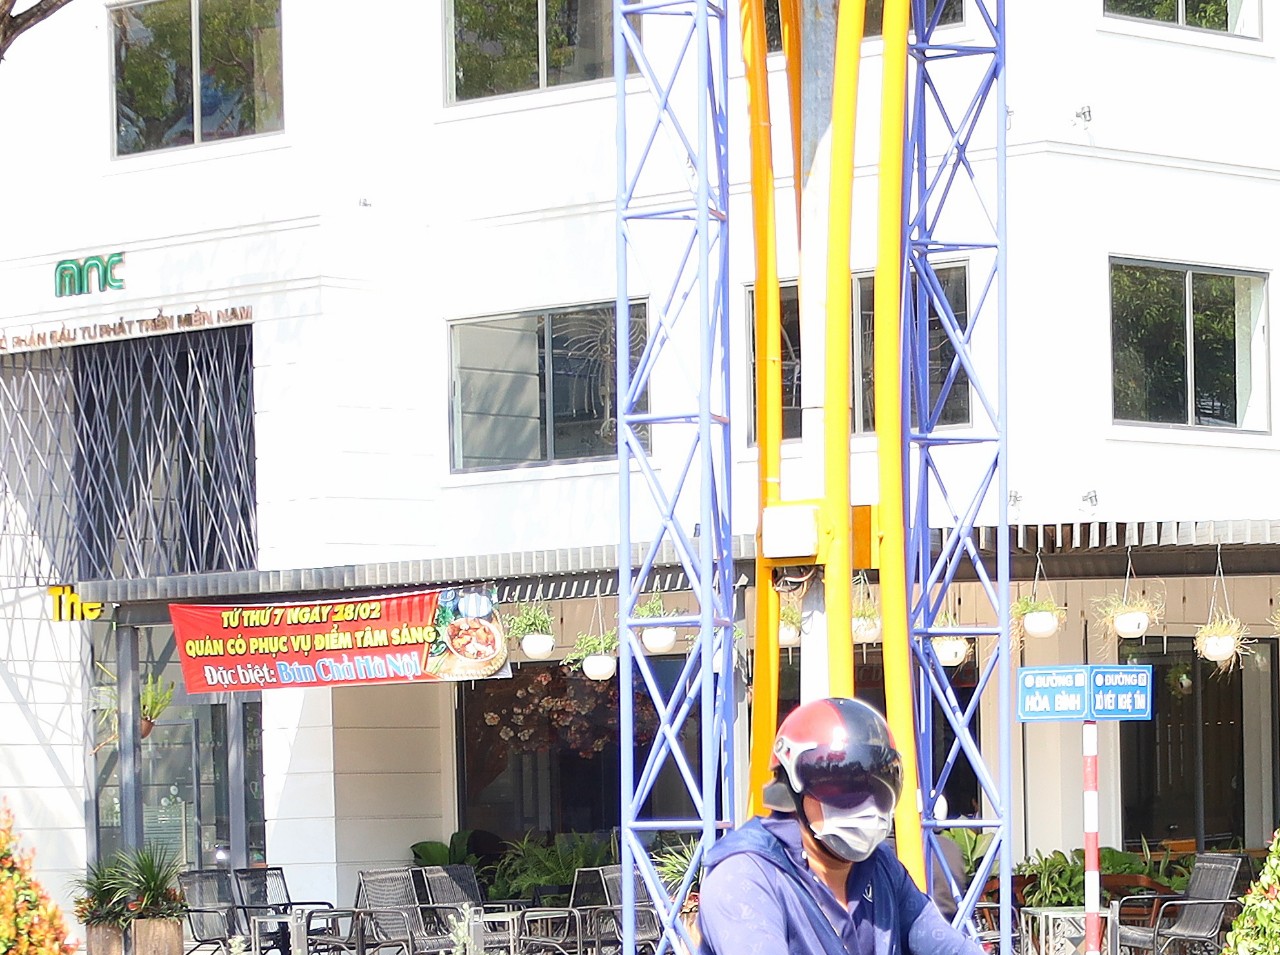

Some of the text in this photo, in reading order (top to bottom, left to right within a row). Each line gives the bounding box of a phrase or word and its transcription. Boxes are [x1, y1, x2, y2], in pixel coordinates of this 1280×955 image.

[217, 305, 252, 323] NAM
[273, 608, 286, 626] 7
[332, 601, 381, 622] 28/02
[185, 622, 437, 658] QUÁN CÓ PHỤC VỤ ĐIỂM TÂM SÁNG
[203, 665, 238, 688] Đặc
[236, 663, 277, 687] biệt:
[276, 660, 317, 684] Bún
[315, 653, 356, 682] Chả
[385, 651, 422, 681] Nội
[1035, 672, 1073, 688] ĐƯỜNG
[1104, 672, 1138, 686] ĐƯỜNG
[1024, 690, 1081, 712] HÒA BÌNH
